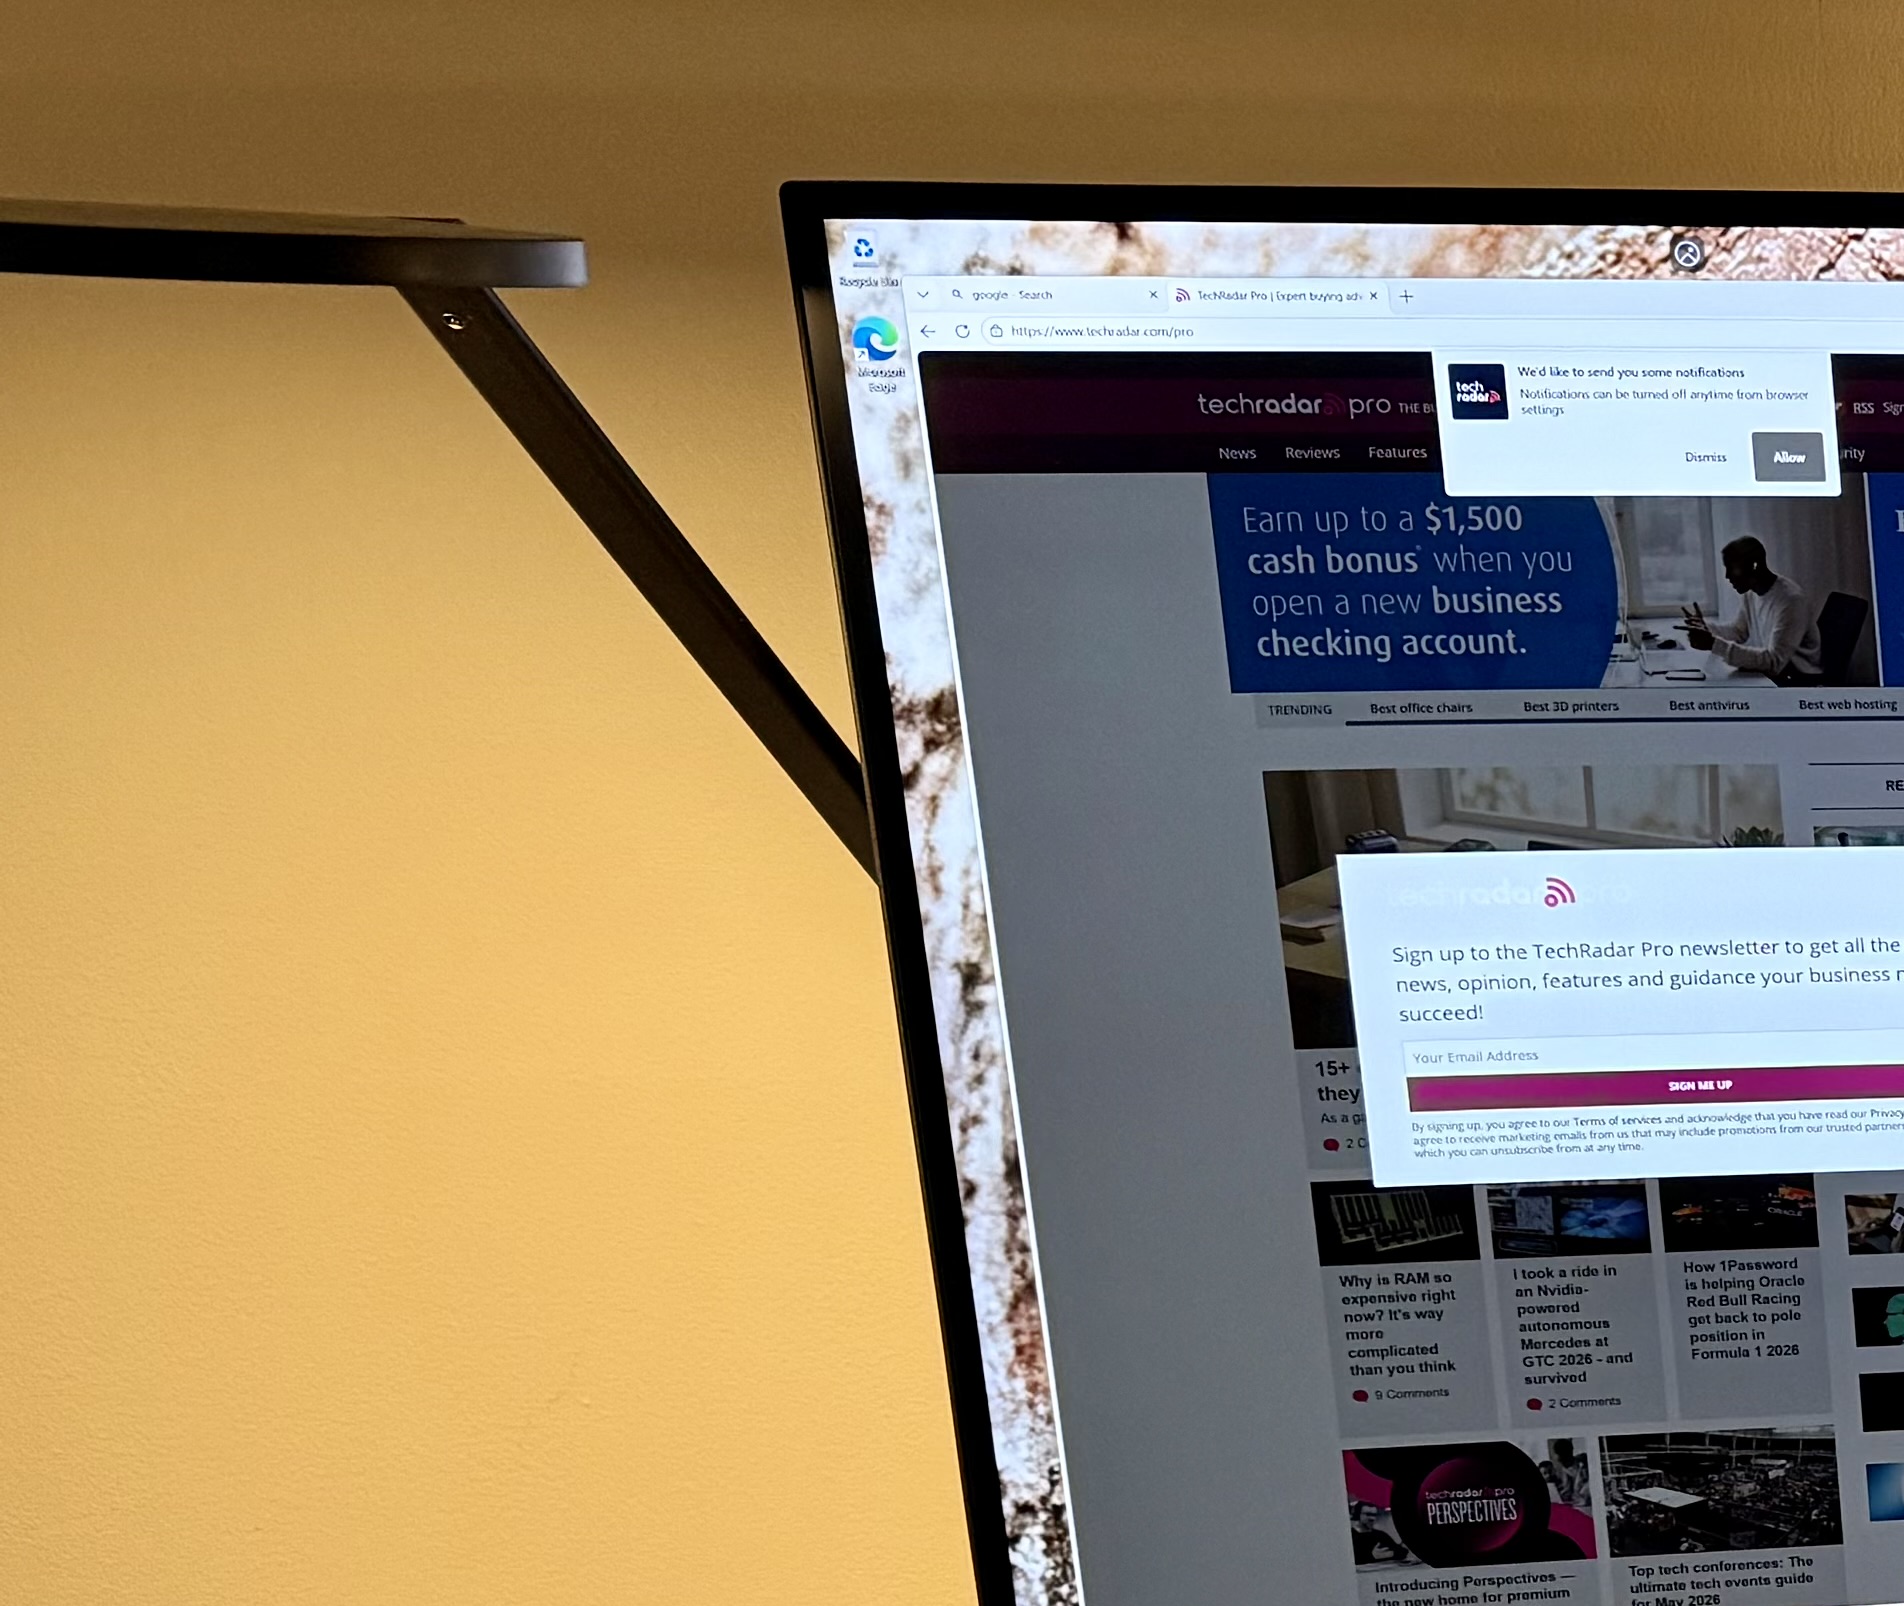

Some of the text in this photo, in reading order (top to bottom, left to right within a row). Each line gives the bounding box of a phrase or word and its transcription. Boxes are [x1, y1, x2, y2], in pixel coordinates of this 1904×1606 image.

[1518, 366, 1546, 376] We'd
[1550, 367, 1569, 377] like
[1572, 368, 1584, 377] to
[1588, 367, 1614, 377] send
[1617, 370, 1638, 380] you
[1676, 367, 1744, 377] notifications
[1456, 381, 1484, 393] tech
[1457, 391, 1490, 402] radar
[1198, 393, 1391, 419] techradar pro
[1219, 447, 1427, 459] News Reviews Features
[1686, 452, 1727, 462] Dismiss
[1774, 451, 1805, 463] Allow
[1244, 502, 1522, 537] Earn up to a $1,500
[1248, 545, 1315, 574] cash
[1433, 544, 1511, 572] when
[1522, 552, 1571, 579] you
[1253, 586, 1562, 621] open a new business
[1258, 628, 1526, 662] checking account.
[1268, 699, 1897, 715] TRENDING Best office chairs Best 3D printers Best antivirus Best web hosting
[1393, 947, 1433, 967] Sign
[1440, 950, 1464, 965] up
[1471, 947, 1489, 960] to
[1496, 944, 1527, 959] the
[1532, 942, 1635, 959] TechRadar
[1642, 942, 1673, 956] Pro
[1680, 940, 1779, 956] newsletter
[1785, 941, 1803, 954] to
[1810, 940, 1838, 958] get
[1845, 937, 1864, 953] all
[1871, 937, 1900, 952] the
[1397, 980, 1451, 993] news,
[1458, 974, 1536, 994] opinion,
[1543, 973, 1622, 988] features
[1628, 970, 1663, 986] and
[1670, 969, 1755, 990] guidance
[1760, 972, 1803, 988] your
[1809, 967, 1890, 982] business
[1400, 1005, 1483, 1021] succeed!
[1413, 1051, 1539, 1063] Your Email Address
[1427, 1498, 1517, 1524] PERSPECTIVES
[1628, 1556, 1813, 1579] Top tech conferences: The
[1630, 1572, 1813, 1593] ultimate tech events guide
[1688, 1594, 1720, 1606] 2026
